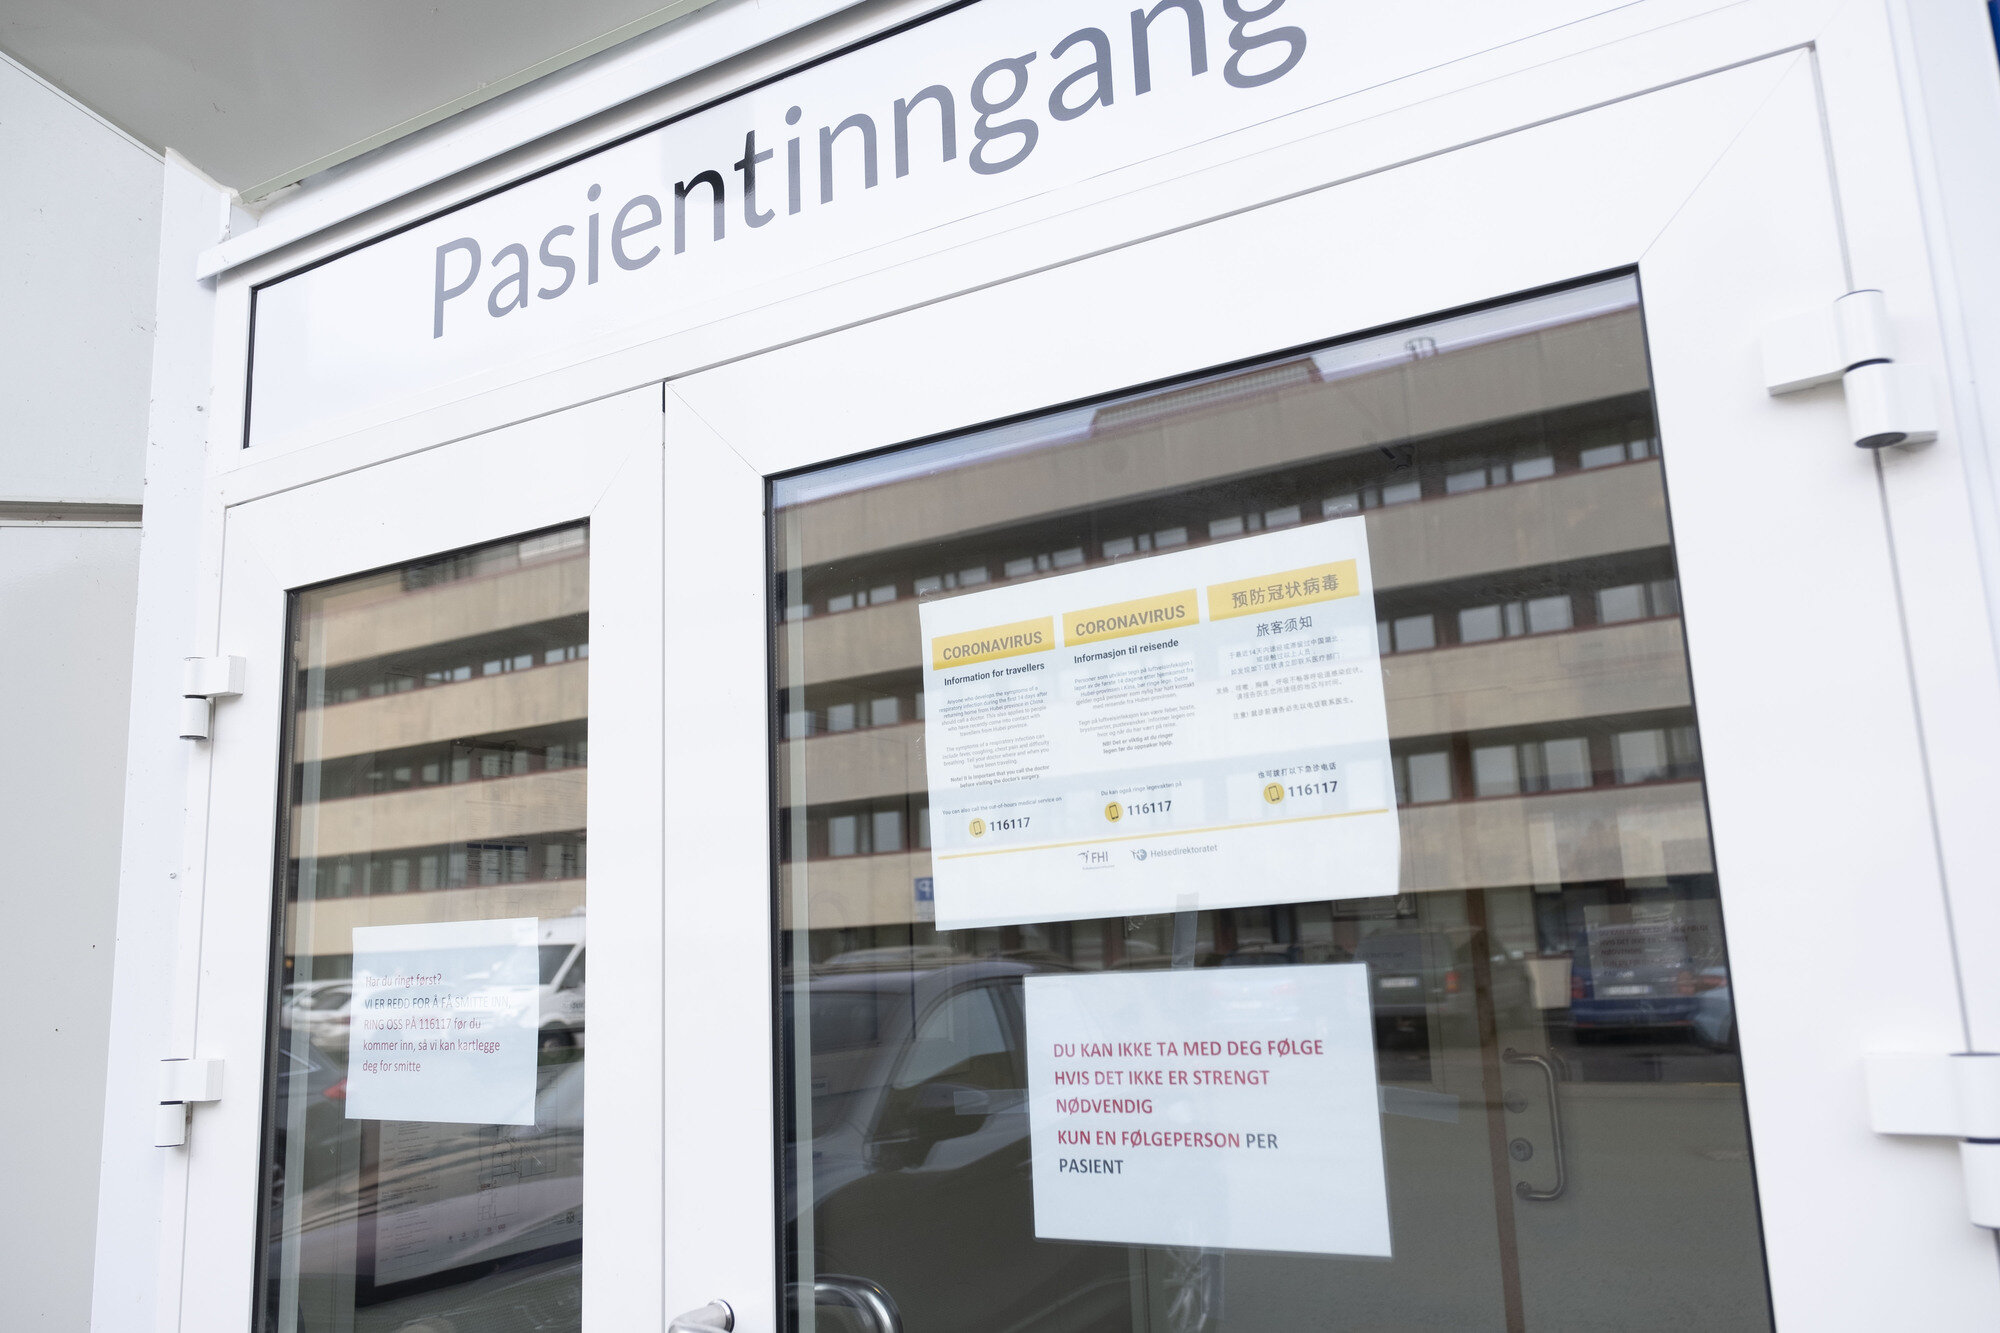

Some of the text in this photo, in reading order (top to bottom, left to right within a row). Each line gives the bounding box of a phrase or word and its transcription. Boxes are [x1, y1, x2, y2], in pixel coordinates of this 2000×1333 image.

[433, 0, 1309, 338] Pasientinngang
[1231, 572, 1339, 608] 预防冠状病毒
[1075, 604, 1185, 636] CORONAVIRUS
[1256, 614, 1312, 637] 旅客须知
[943, 630, 1042, 660] CORONAVIRUS
[1074, 638, 1178, 665] Informasjon til reisende
[944, 661, 1044, 686] Information for travellers
[1288, 780, 1337, 796] 116117
[1128, 800, 1171, 815] 116117
[990, 816, 1030, 831] 116117
[1091, 851, 1108, 863] FHI
[1150, 843, 1217, 858] Helsedirektoratet
[366, 973, 442, 988] Har du ringt først?
[365, 999, 373, 1009] VI
[375, 999, 384, 1009] ER
[387, 998, 410, 1009] REDD
[413, 998, 430, 1008] FOR
[432, 995, 439, 1008] Å
[441, 994, 453, 1008] FÅ
[455, 996, 489, 1008] SMITTE
[364, 1016, 481, 1030] RING OSS PÅ 116117 før du
[363, 1039, 500, 1053] kommer inn, så vi kan kartlegge
[1054, 1039, 1324, 1058] DU KAN IKKE TA MED DEG FØLGE
[363, 1060, 421, 1074] deg for smitte
[1055, 1070, 1269, 1085] HVIS DET IKKE ER STRENGT
[1056, 1097, 1153, 1115] NØDVENDIG
[1058, 1129, 1279, 1149] KUN EN FØLGEPERSON PER
[1059, 1158, 1124, 1174] PASIENT
